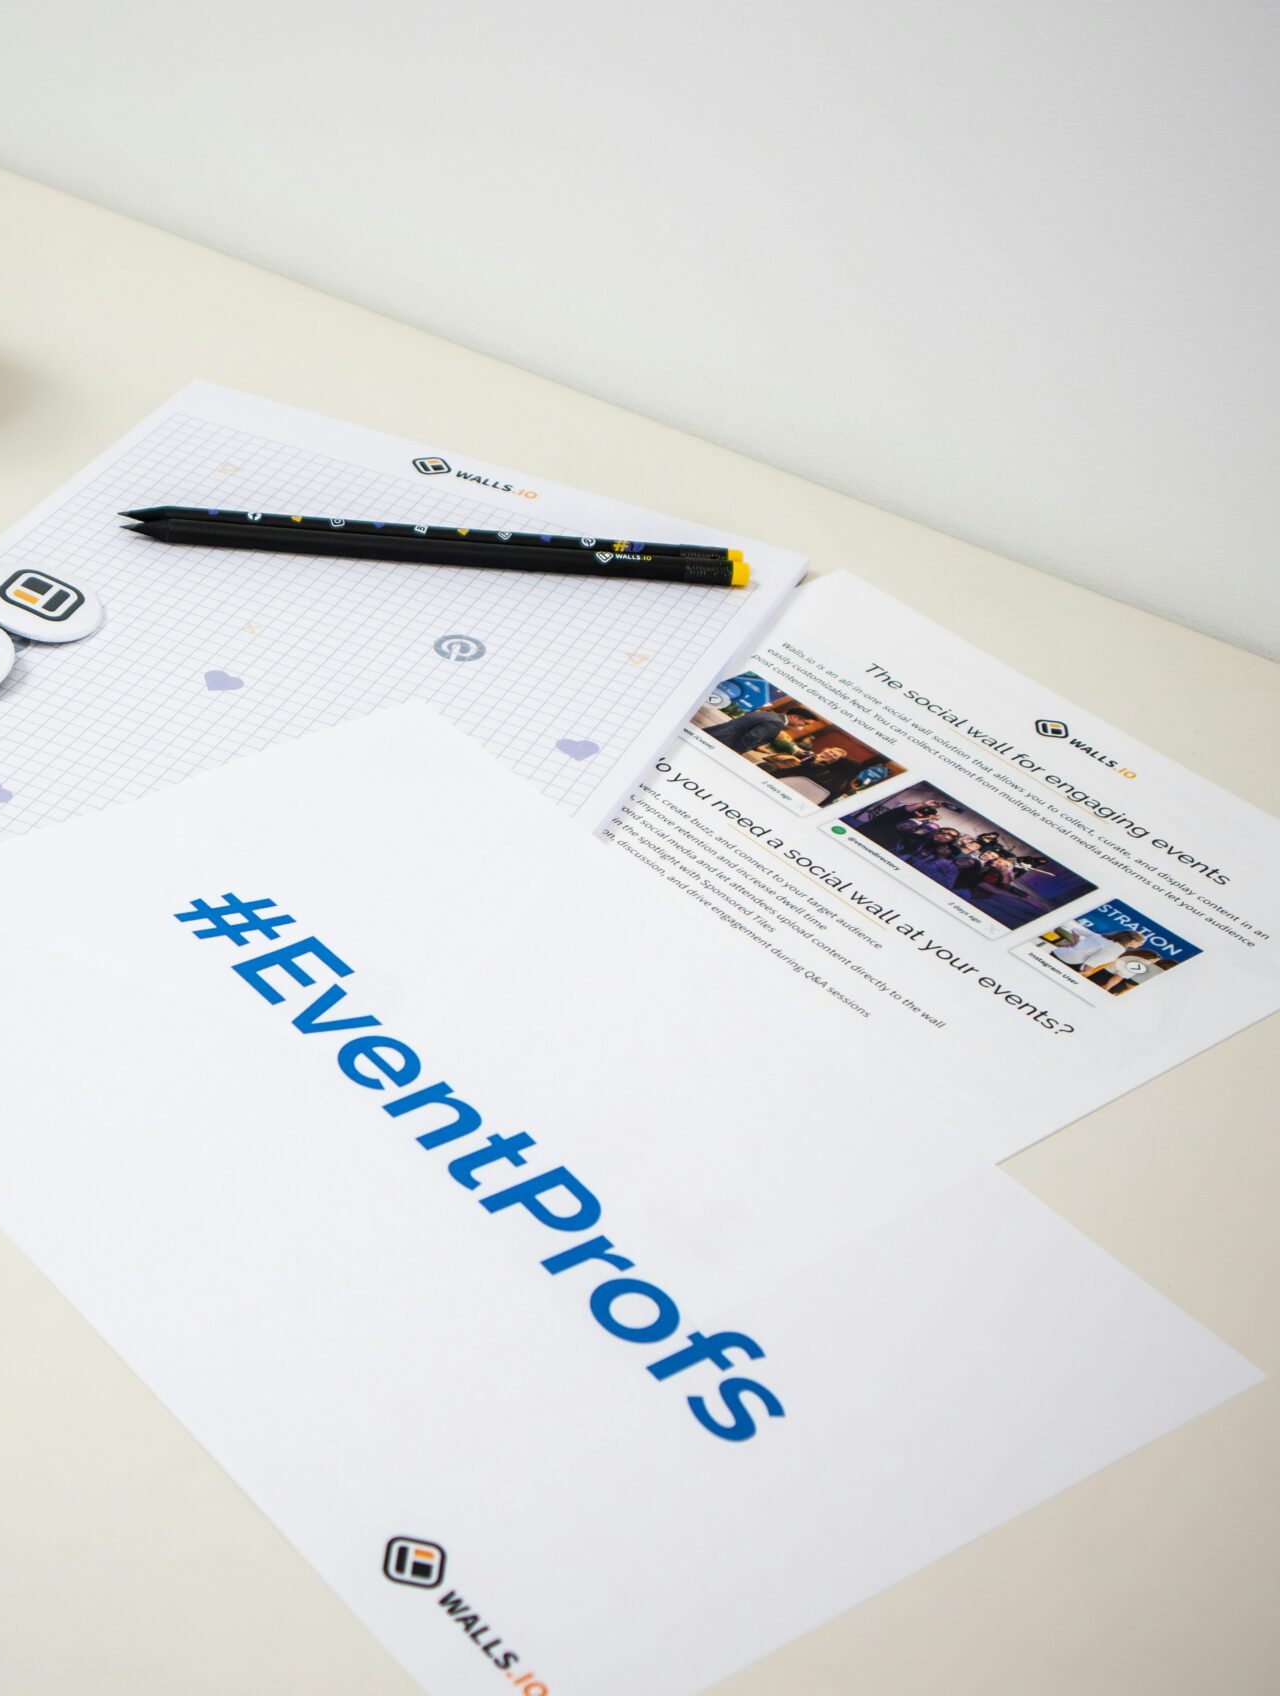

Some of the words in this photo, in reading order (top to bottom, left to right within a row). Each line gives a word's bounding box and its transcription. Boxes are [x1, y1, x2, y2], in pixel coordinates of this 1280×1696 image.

[455, 470, 538, 500] WALLS.IO
[615, 553, 652, 561] WALLS.IO
[749, 654, 773, 667] post
[772, 667, 807, 688] content
[806, 688, 841, 709] directly
[840, 709, 853, 718] on
[850, 717, 875, 730] your
[875, 730, 897, 745] wall.
[1069, 737, 1138, 780] WALLS.IO
[767, 649, 793, 664] easily
[792, 664, 850, 700] customizable
[849, 699, 872, 714] feed.
[873, 713, 890, 725] You
[889, 725, 907, 736] can
[906, 735, 939, 755] collect
[937, 754, 976, 777] content
[974, 776, 999, 792] from
[998, 791, 1040, 816] multiple
[1039, 816, 1071, 835] social
[1069, 834, 1102, 854] media
[1099, 854, 1152, 885] platforms
[1151, 884, 1165, 892] or
[1164, 891, 1180, 902] let
[1177, 901, 1206, 916] your
[1204, 917, 1255, 947] audience
[781, 642, 815, 663] Walls.io
[838, 679, 882, 705] all-in-one
[882, 705, 911, 722] social
[911, 722, 933, 735] wall
[931, 735, 970, 759] solution
[971, 759, 993, 772] that
[992, 773, 1025, 792] allows
[1023, 792, 1045, 805] you
[1046, 804, 1058, 812] to
[1059, 813, 1094, 836] collect,
[1097, 836, 1130, 858] curate,
[1134, 858, 1158, 871] and
[1157, 872, 1196, 895] display
[1196, 896, 1239, 921] content
[1240, 920, 1252, 929] in
[1253, 930, 1269, 939] an
[865, 663, 902, 688] The
[903, 690, 968, 727] social
[967, 726, 1013, 754] wall
[1010, 753, 1045, 772] for
[1045, 775, 1149, 838] engaging
[1151, 839, 1230, 884] events
[616, 840, 665, 876] discussion,
[666, 876, 689, 889] and
[686, 889, 711, 905] drive
[711, 906, 772, 948] engagement
[770, 948, 804, 972] during
[804, 970, 827, 987] Q&A
[826, 987, 870, 1017] sessions
[622, 824, 638, 836] the
[637, 836, 680, 865] spotlight
[679, 865, 700, 880] with
[700, 879, 754, 915] Sponsored
[752, 914, 775, 932] Tiles
[636, 799, 675, 825] improve
[674, 825, 717, 855] retention
[716, 855, 738, 868] and
[735, 868, 776, 895] increase
[775, 895, 805, 914] dwell
[802, 913, 827, 929] time
[639, 820, 670, 839] social
[666, 838, 697, 859] media
[695, 859, 718, 872] and
[715, 871, 730, 882] let
[728, 882, 777, 914] attendees
[776, 914, 814, 938] upload
[811, 938, 851, 965] content
[850, 965, 890, 991] directly
[889, 990, 901, 999] to
[901, 999, 920, 1012] the
[920, 1012, 945, 1028] wall
[661, 799, 690, 818] create
[689, 818, 713, 836] buzz,
[714, 836, 737, 849] and
[734, 849, 773, 874] connect
[772, 874, 783, 882] to
[781, 882, 807, 897] your
[806, 897, 837, 918] target
[835, 918, 882, 948] audience
[666, 772, 712, 800] you
[711, 800, 771, 837] need
[766, 838, 783, 848] a
[783, 849, 852, 892] social
[850, 890, 900, 924] wall
[896, 923, 924, 940] at
[917, 939, 978, 973] your
[978, 976, 1074, 1033] events?
[1027, 952, 1062, 974] Instagram
[1061, 973, 1079, 984] User
[173, 891, 786, 1442] #EventProfs
[438, 1590, 549, 1696] WALLS.IO
